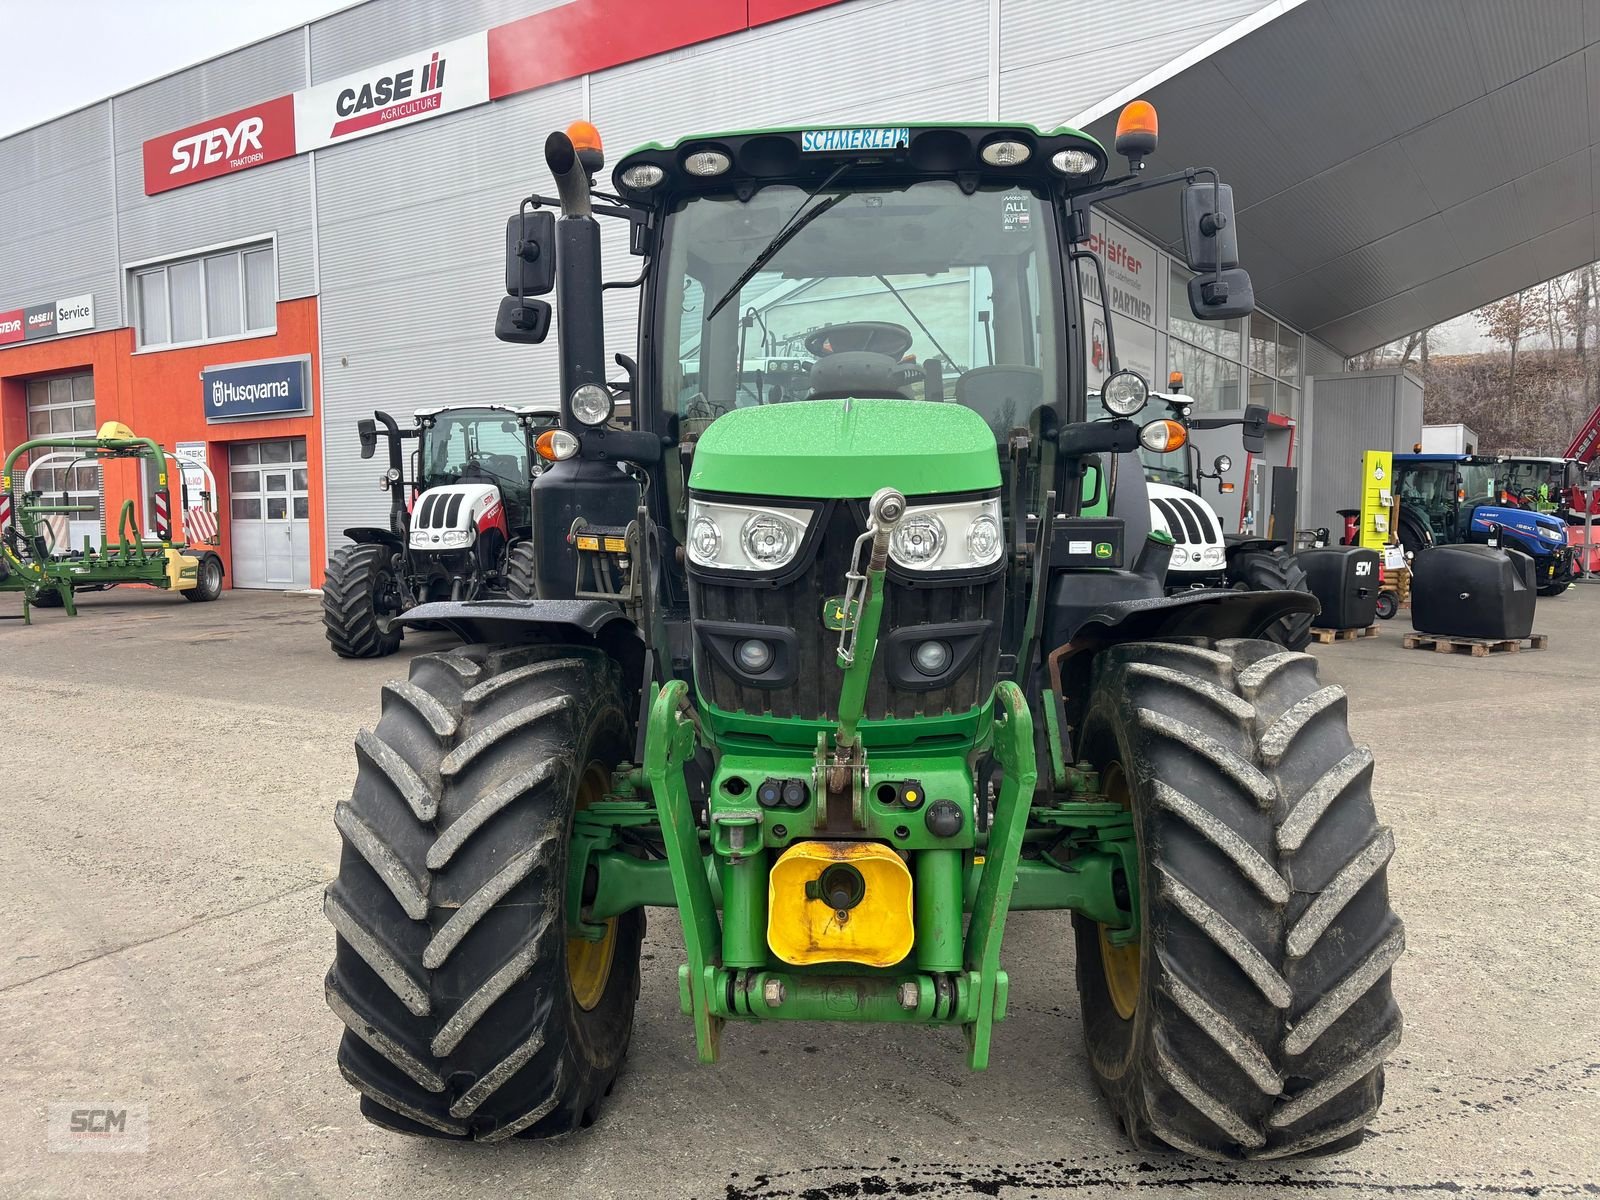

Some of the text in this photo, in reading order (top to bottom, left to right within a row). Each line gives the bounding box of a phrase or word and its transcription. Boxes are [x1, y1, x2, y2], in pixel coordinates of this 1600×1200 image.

[336, 69, 414, 117] CASE
[380, 96, 437, 121] AGRICULTURE
[169, 116, 264, 174] STEYR
[230, 152, 264, 168] TRAKTOREN
[1005, 202, 1028, 212] ALL
[59, 305, 90, 321] Service
[1112, 286, 1152, 323] PARTNER
[29, 313, 47, 325] CASE
[224, 380, 289, 403] Husqvarna
[1355, 561, 1371, 576] SCM
